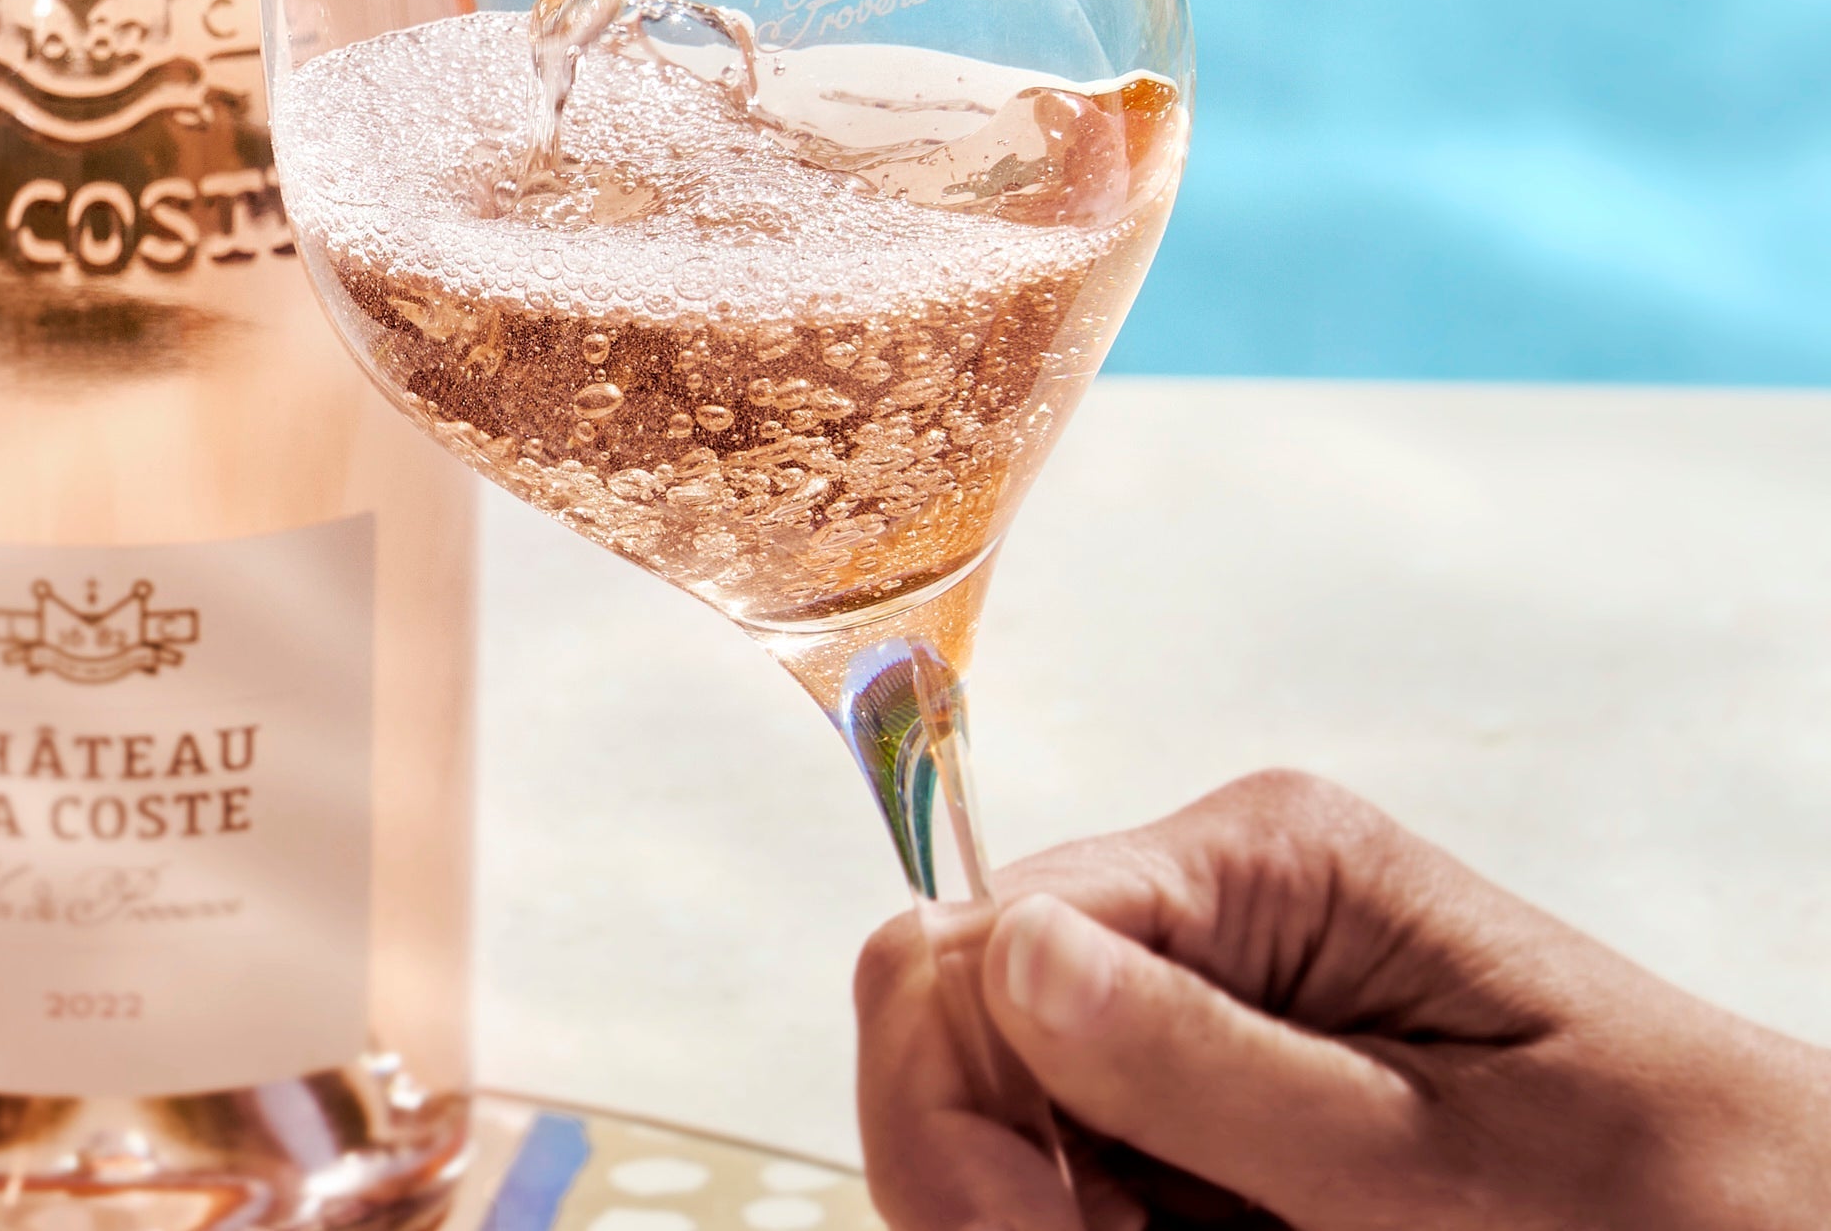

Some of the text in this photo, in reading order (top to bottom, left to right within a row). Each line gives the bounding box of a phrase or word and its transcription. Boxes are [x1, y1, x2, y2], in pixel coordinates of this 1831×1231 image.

[5, 167, 296, 269] COST
[49, 786, 253, 842] COSTE
[43, 991, 144, 1020] 2022
